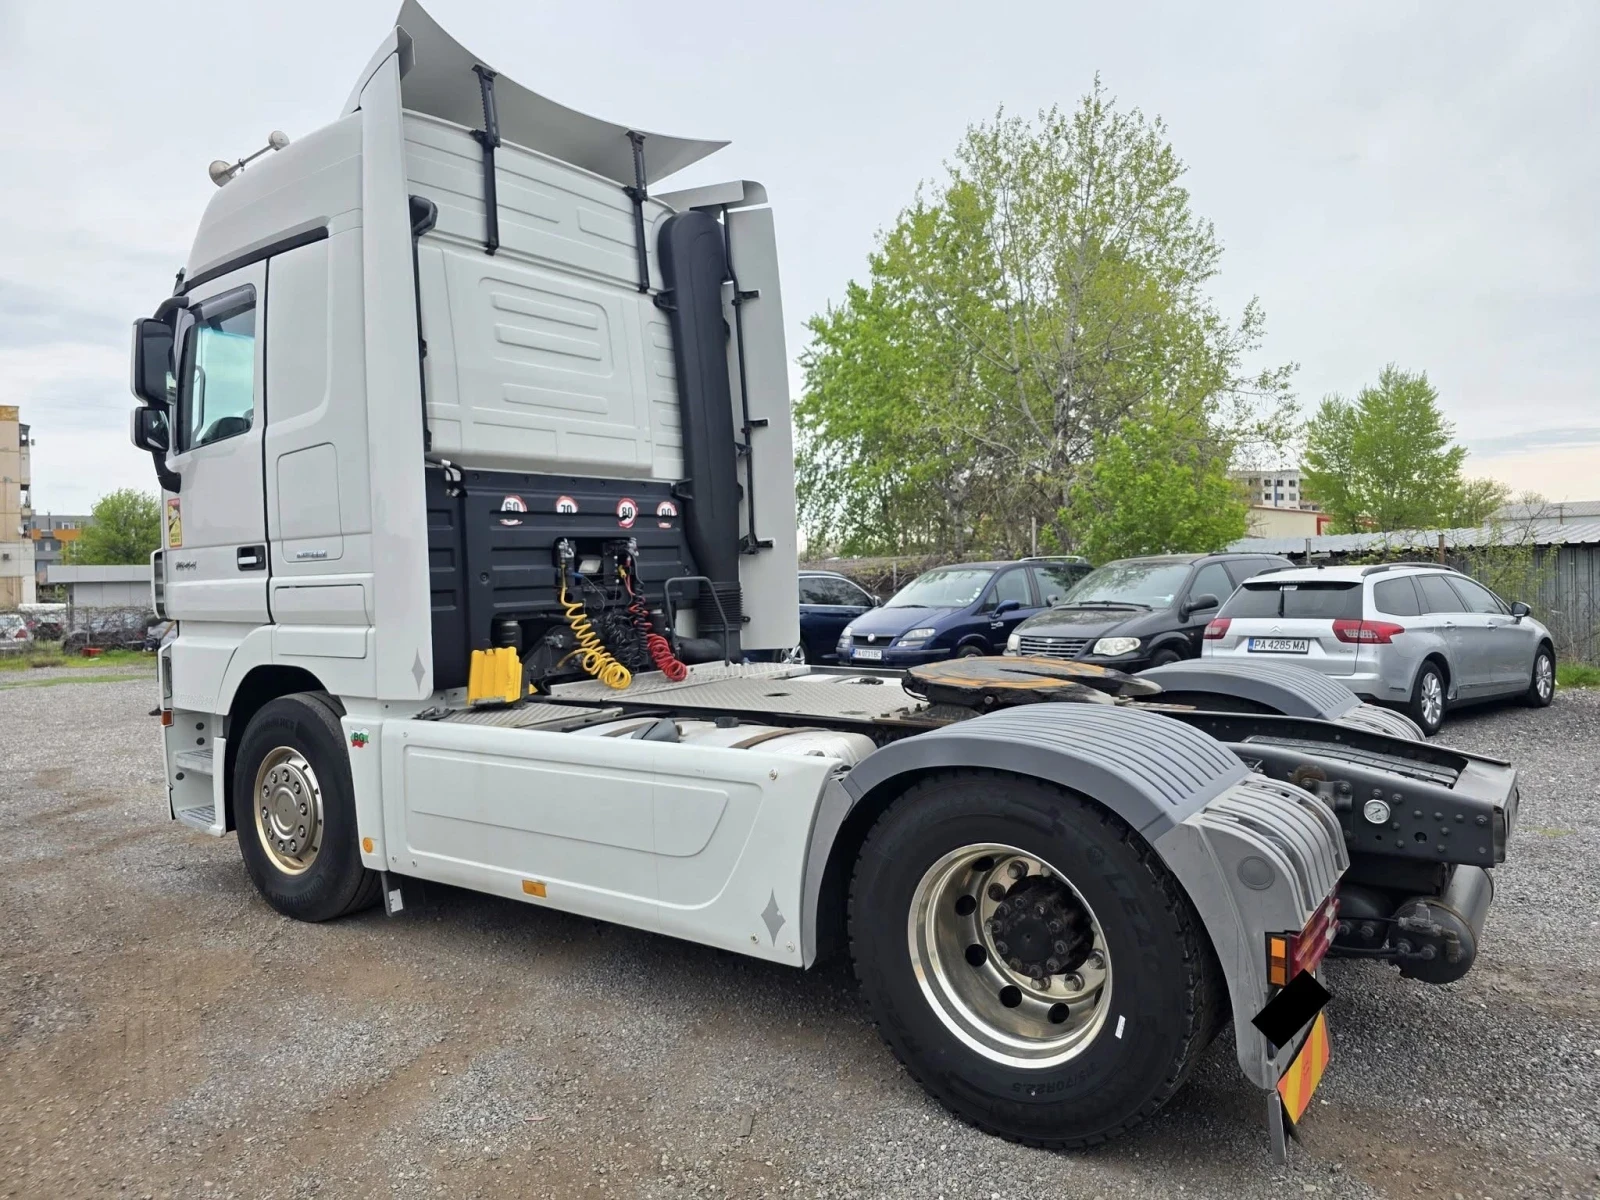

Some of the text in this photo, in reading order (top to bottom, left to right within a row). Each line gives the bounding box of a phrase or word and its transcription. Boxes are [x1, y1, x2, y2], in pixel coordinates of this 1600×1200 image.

[622, 507, 633, 519] 80
[1254, 640, 1306, 651] PA 4285 MA
[353, 732, 365, 742] BG
